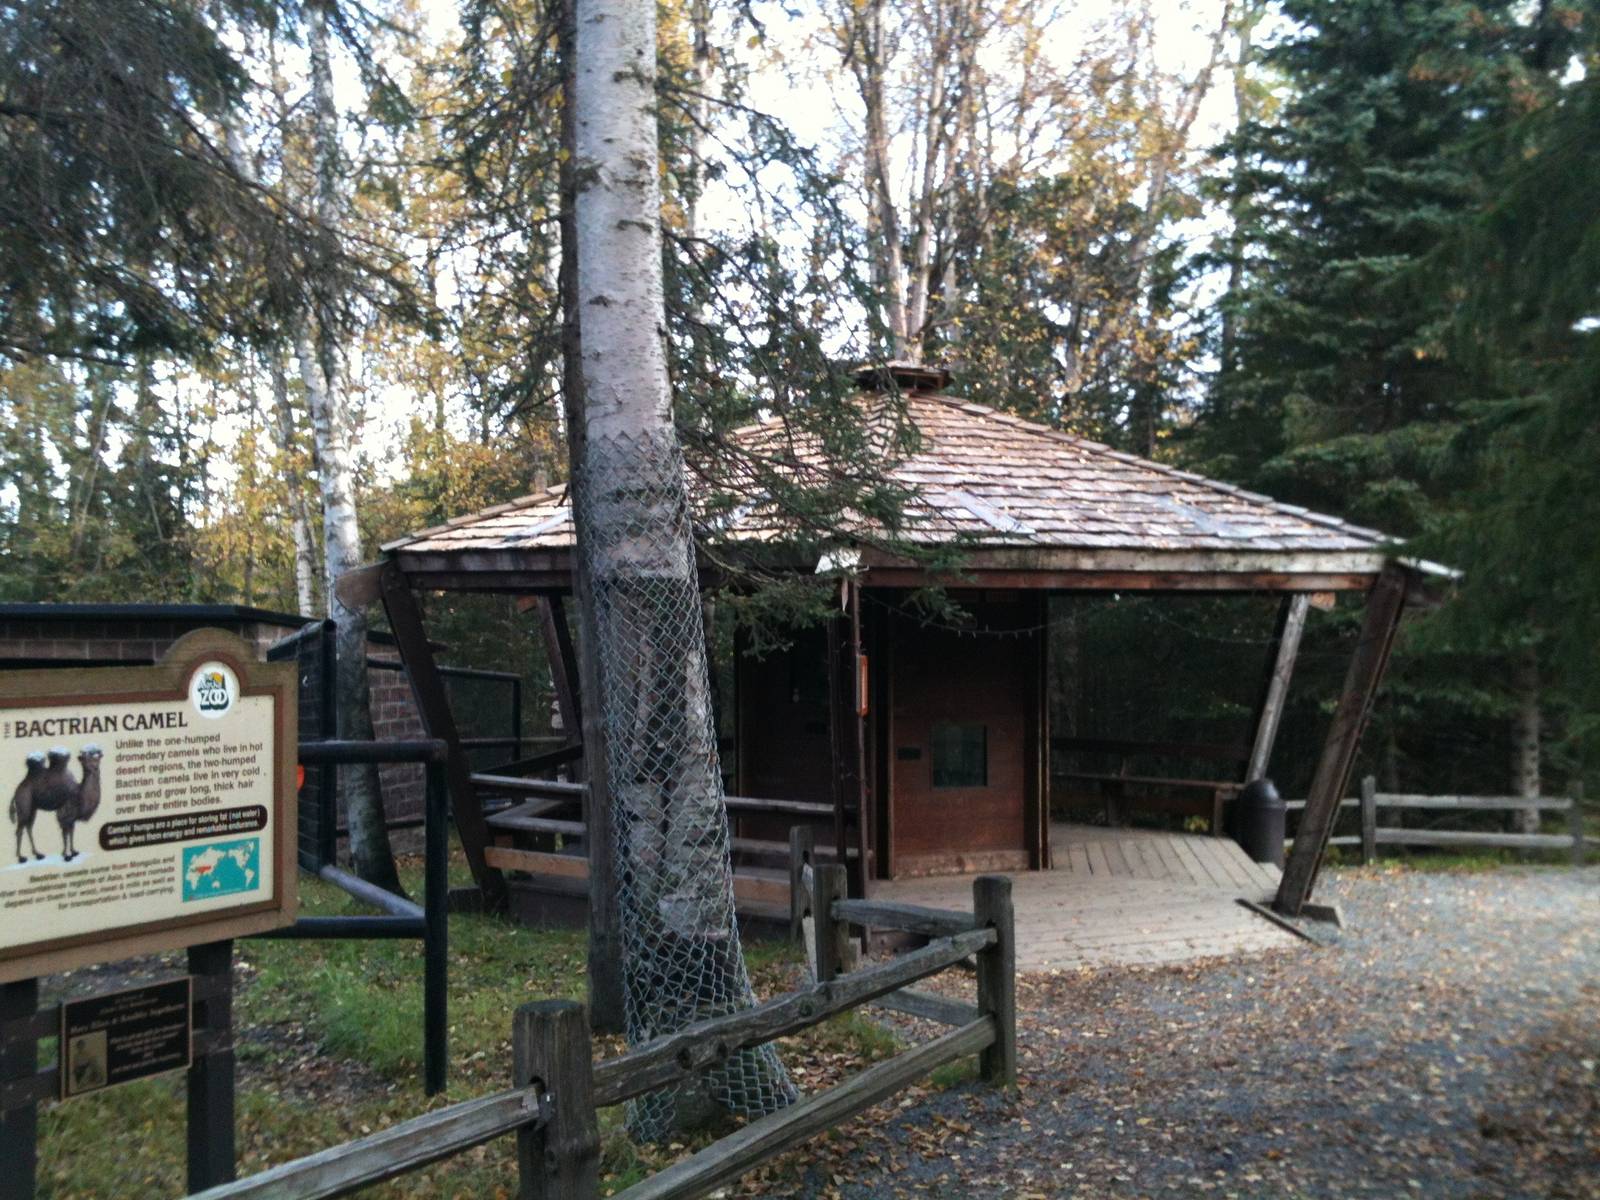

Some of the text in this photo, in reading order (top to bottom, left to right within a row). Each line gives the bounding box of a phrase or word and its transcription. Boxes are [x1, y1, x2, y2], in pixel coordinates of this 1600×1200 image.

[200, 688, 228, 709] ZOO
[15, 716, 118, 738] BACTRIAN
[122, 712, 188, 732] CAMEL
[116, 734, 220, 749] Unlike the one-humped
[116, 743, 263, 762] dromedary camels who live in hot
[116, 756, 256, 776] desert regions, the two-humped
[116, 767, 260, 789] Bactrian camels live in very cold
[116, 780, 254, 802] areas and grow long, thick hair
[116, 796, 222, 815] over their entire bodies.
